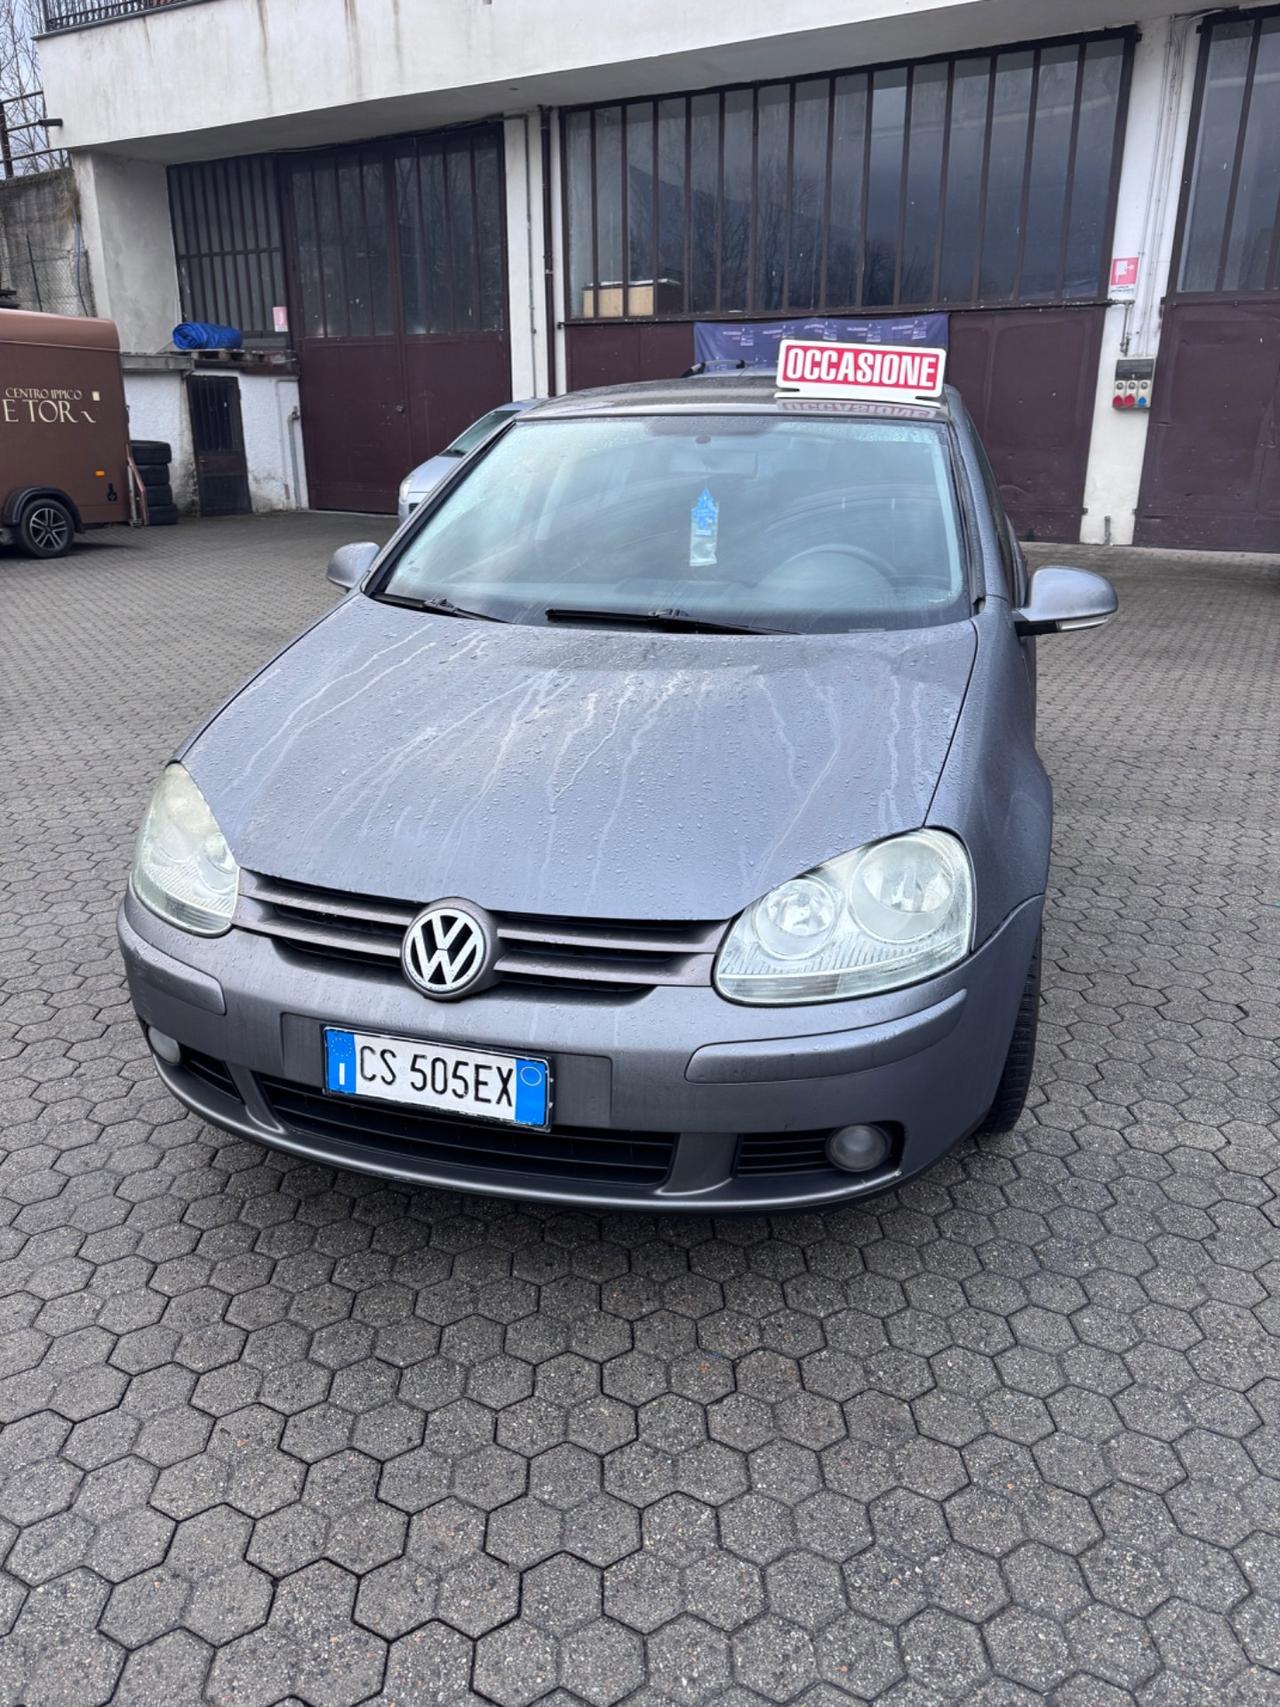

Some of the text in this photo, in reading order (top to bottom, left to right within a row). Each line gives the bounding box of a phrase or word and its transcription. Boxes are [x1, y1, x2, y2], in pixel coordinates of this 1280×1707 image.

[786, 347, 936, 387] OCCASIONE
[5, 387, 82, 401] CENTRO IPPICO
[22, 399, 96, 423] TOR
[406, 910, 483, 991] VW
[359, 1045, 397, 1086] CS
[409, 1053, 515, 1107] 505EX
